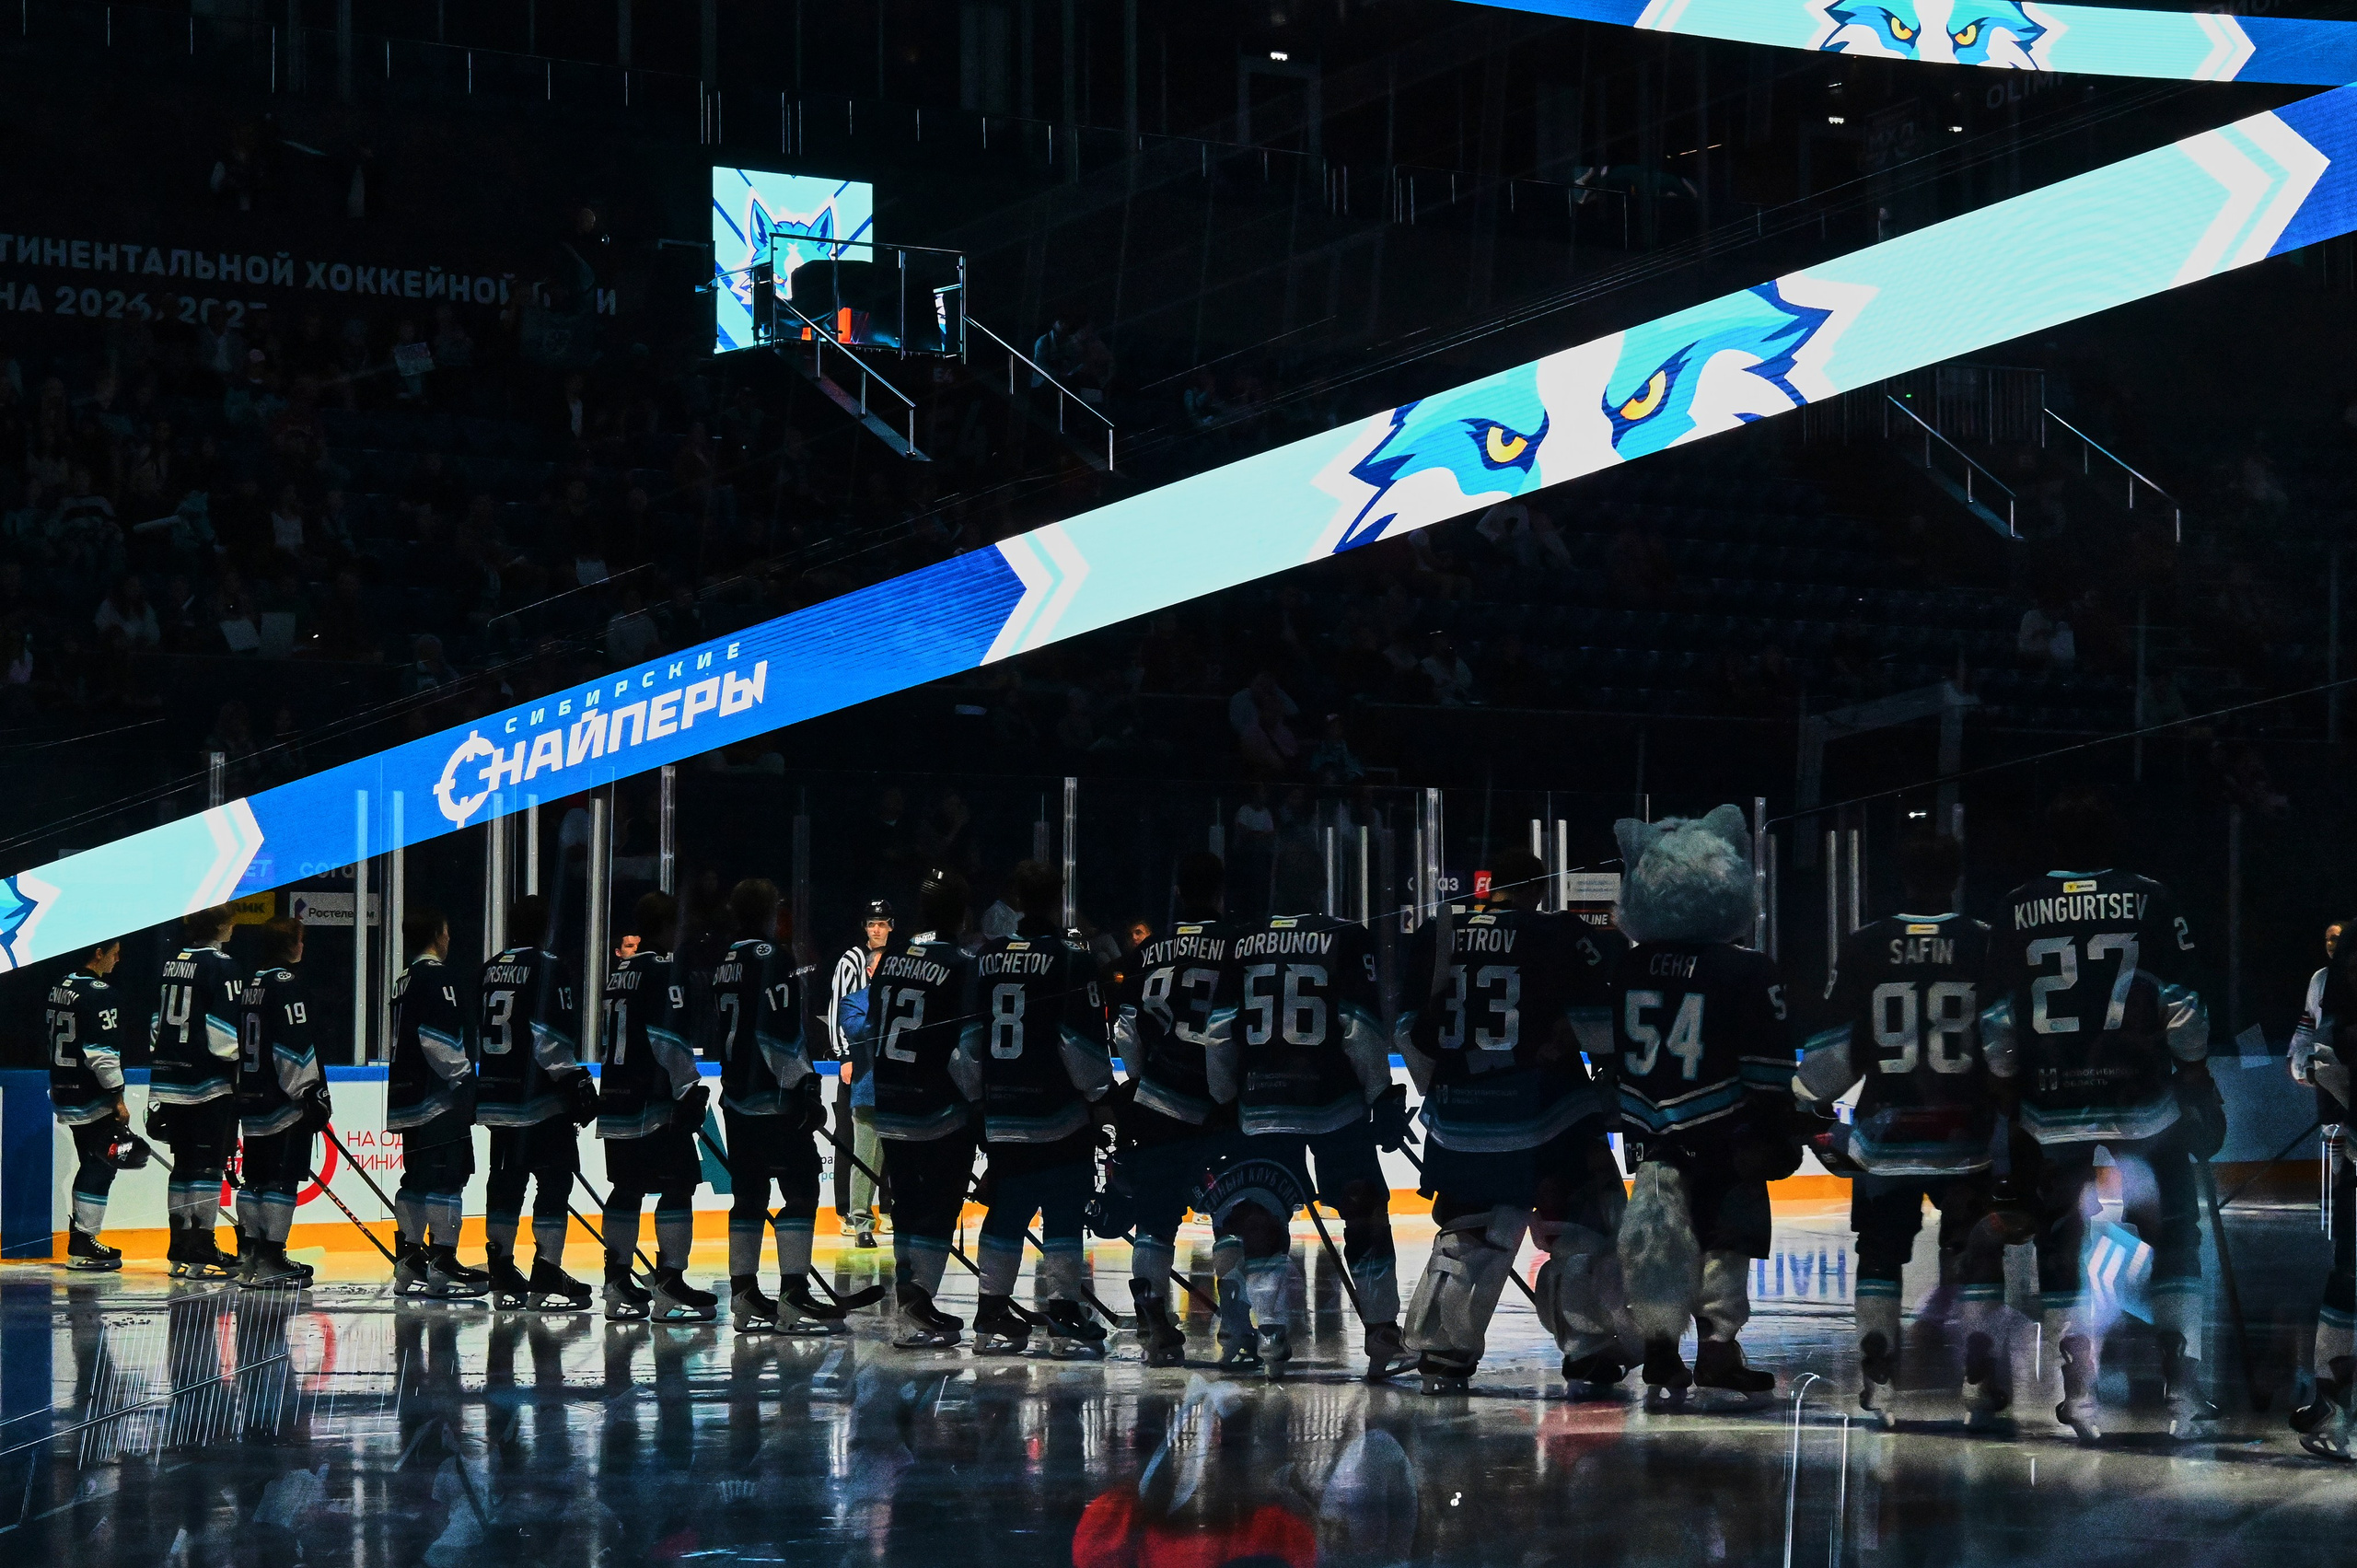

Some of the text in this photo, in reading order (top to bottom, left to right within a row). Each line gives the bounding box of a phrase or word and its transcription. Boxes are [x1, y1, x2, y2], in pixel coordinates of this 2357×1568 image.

[505, 642, 740, 734] СИБИРСКИЕ
[433, 659, 769, 829] СНАЙПЕРЫ
[309, 907, 375, 919] Ростелем
[2014, 891, 2149, 931] KUNGURTSEV
[1234, 930, 1333, 960] GORBUNOV
[1888, 937, 1955, 965] SAFIN
[978, 952, 1056, 977] KOCHETOV
[1649, 952, 1699, 979] СЕНЯ
[441, 985, 458, 1007] 4
[558, 986, 573, 1010] 13
[765, 982, 790, 1012] 17
[1086, 981, 1101, 1008] 8
[2026, 932, 2140, 1035] 27
[99, 1007, 119, 1031] 32
[284, 1001, 308, 1026] 19
[1141, 965, 1221, 1046] 83
[1242, 963, 1329, 1046] 56
[1437, 964, 1521, 1051] 33
[875, 984, 926, 1063] 12
[991, 982, 1026, 1060] 8
[1622, 989, 1707, 1082] 54
[1872, 981, 1977, 1074] 98
[347, 1131, 376, 1147] НА
